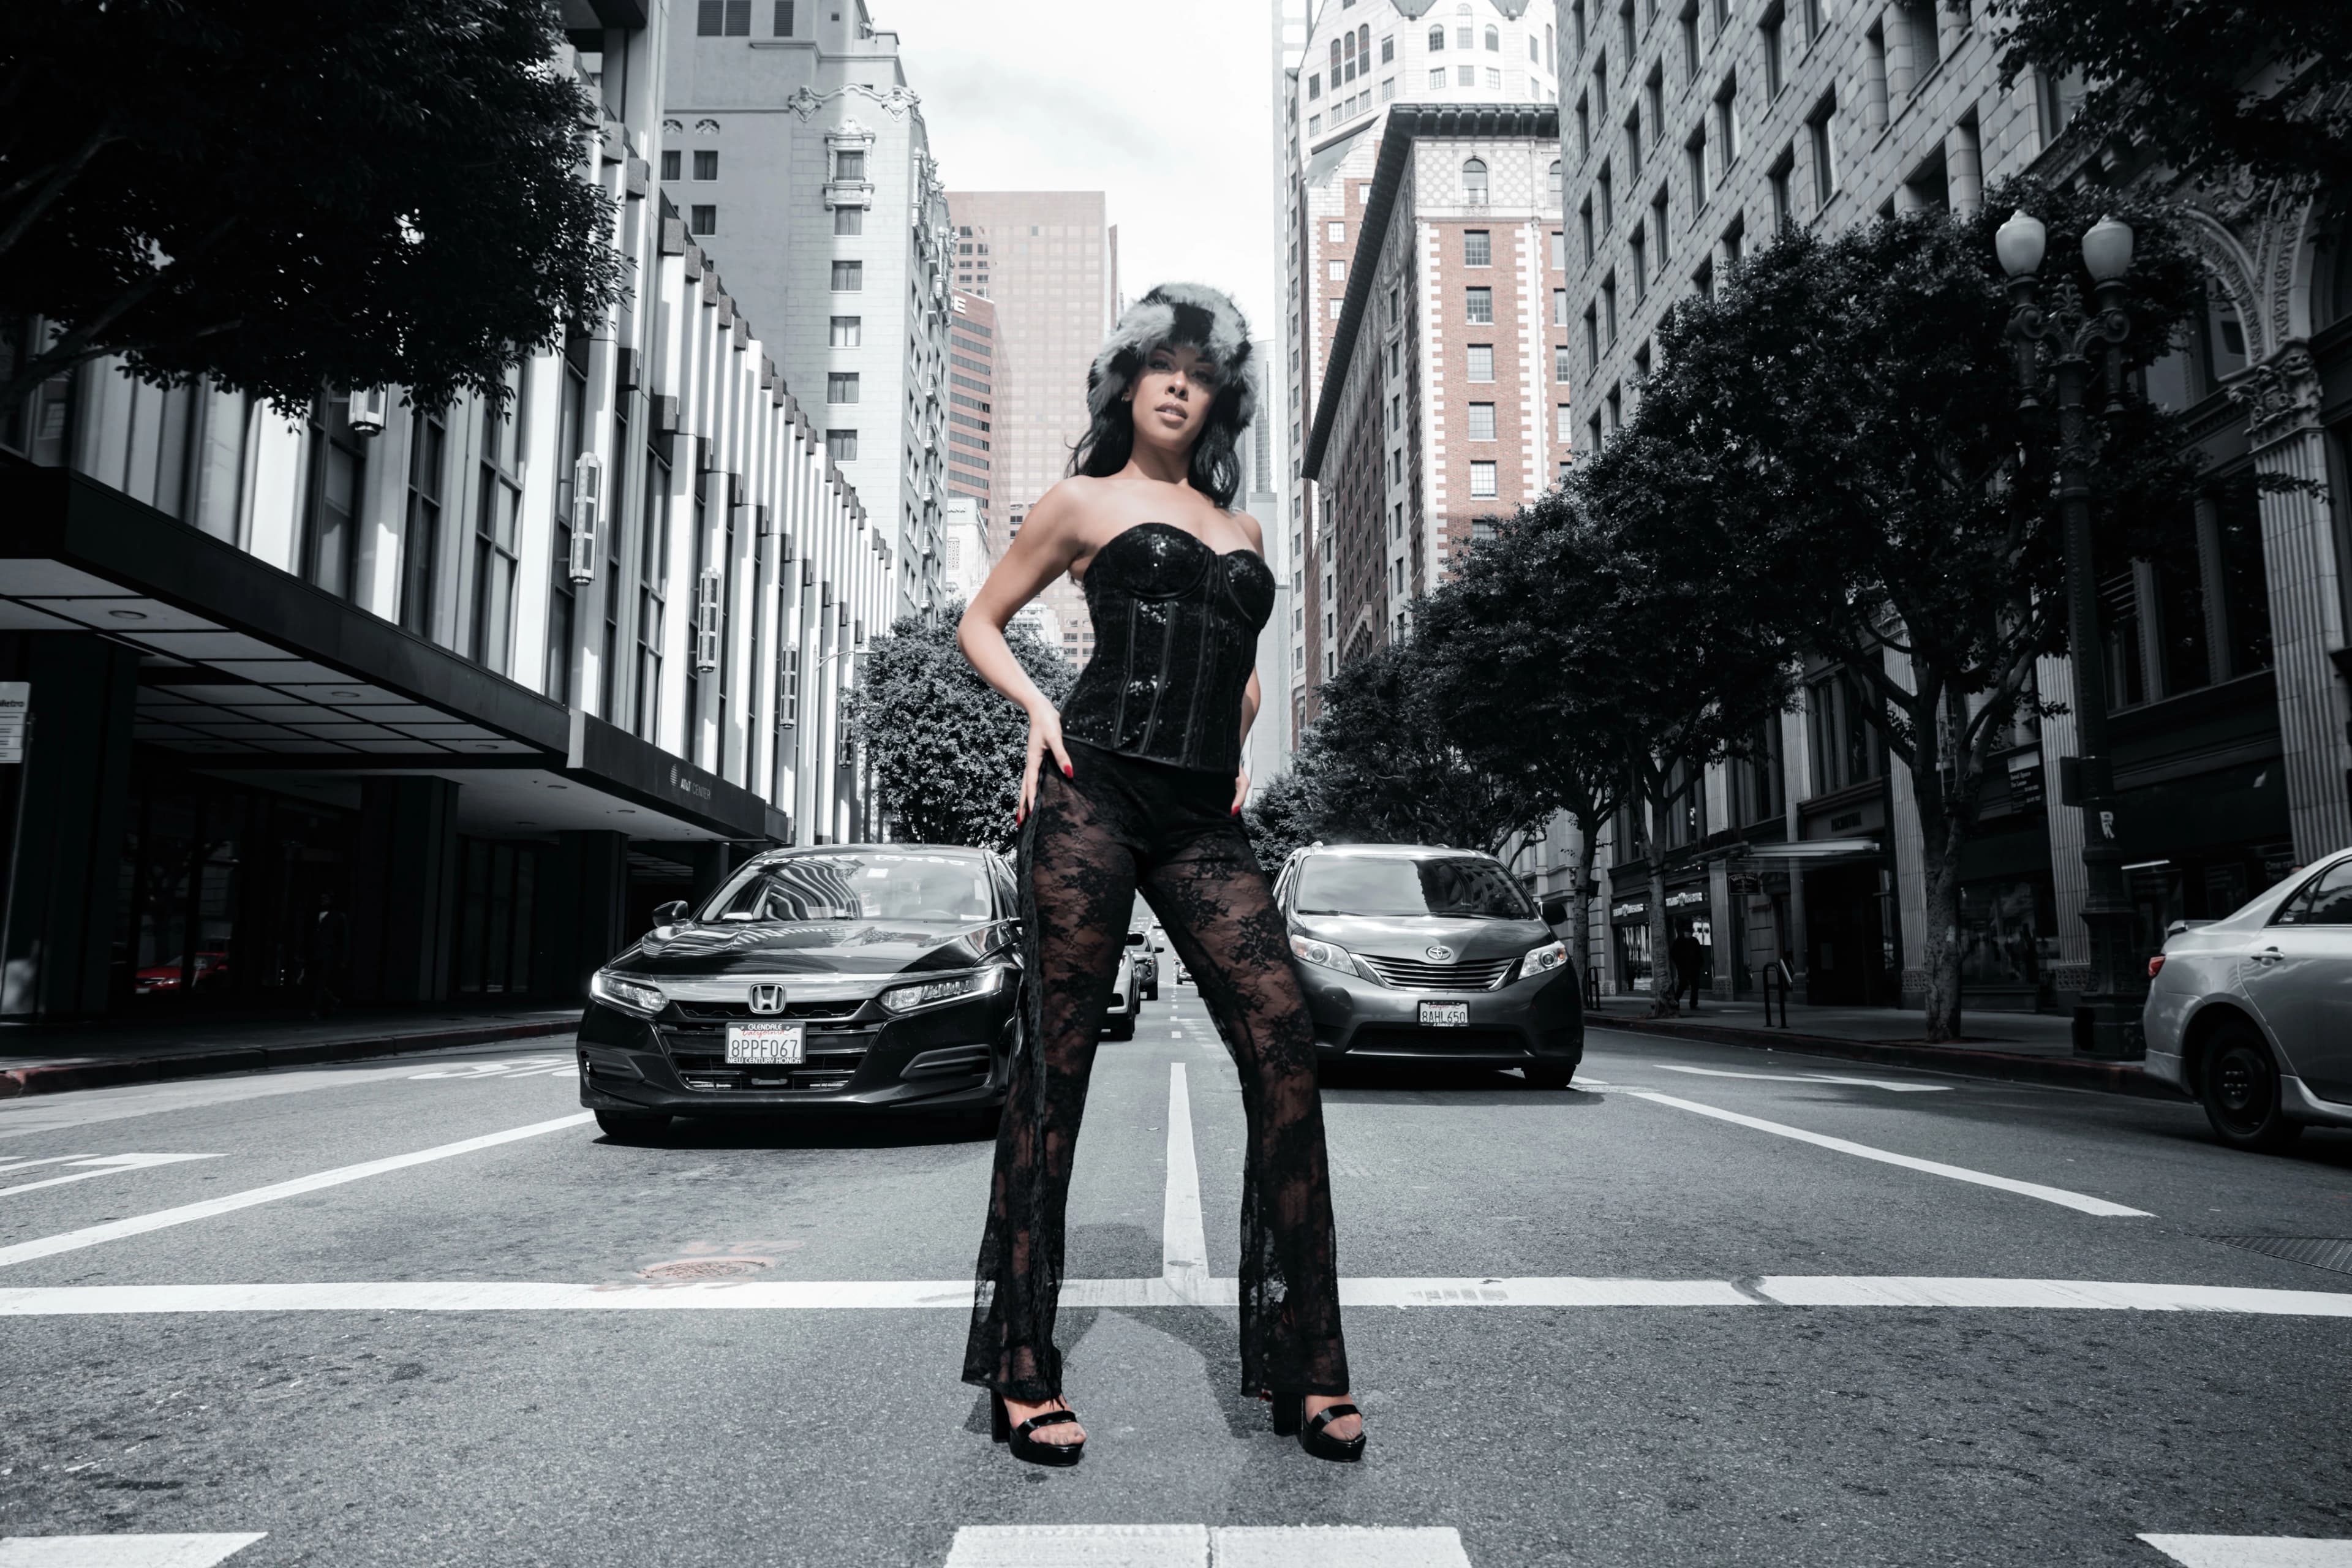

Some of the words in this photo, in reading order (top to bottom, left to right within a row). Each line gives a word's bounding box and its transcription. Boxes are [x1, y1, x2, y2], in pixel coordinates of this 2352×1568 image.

[951, 296, 965, 314] E
[692, 783, 710, 799] CENTER
[1422, 1011, 1465, 1023] 8AHL650
[731, 1039, 797, 1058] 8PPF067
